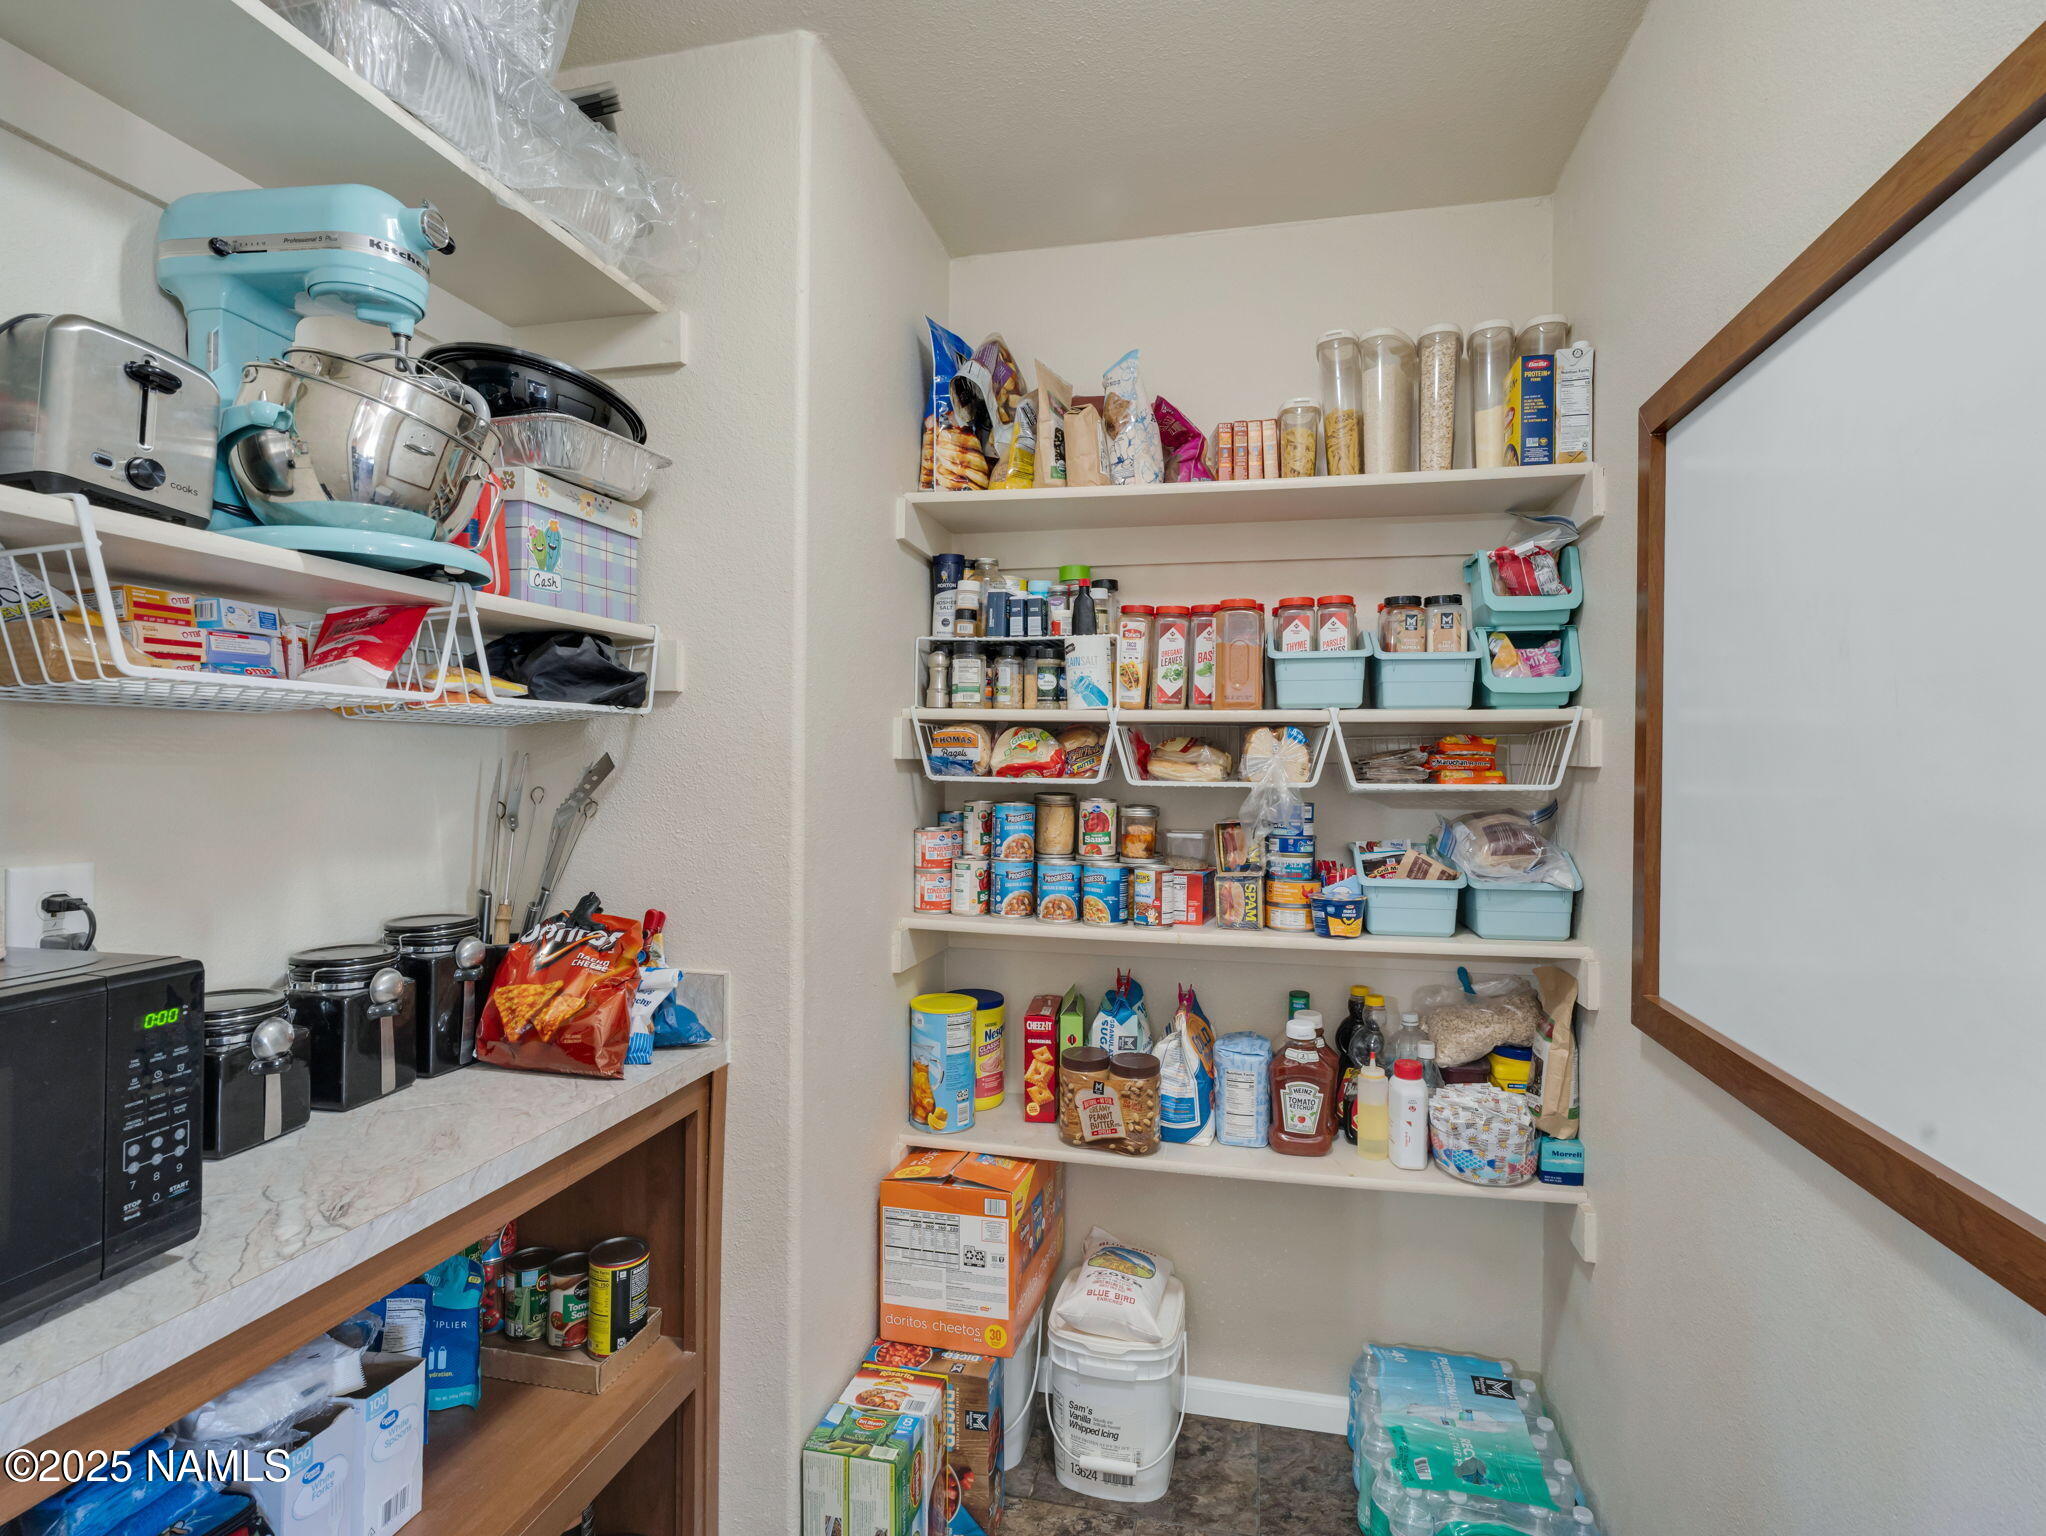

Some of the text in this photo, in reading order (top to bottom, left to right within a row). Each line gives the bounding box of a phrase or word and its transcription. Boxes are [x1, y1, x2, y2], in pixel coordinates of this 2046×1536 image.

[170, 482, 199, 496] cooks
[533, 573, 558, 588] Cash
[1286, 639, 1308, 651] THYME
[1322, 635, 1346, 648] PARSLEY
[1161, 655, 1183, 667] LEAVES
[1197, 650, 1213, 663] BAS
[1076, 758, 1095, 770] BUTTER
[1084, 835, 1110, 843] Sauce
[1044, 873, 1073, 883] PROGRESSO
[1244, 883, 1257, 921] SPAM
[571, 959, 609, 972] CHEESE
[576, 952, 610, 967] NACHO
[144, 1008, 179, 1029] 0:00
[1100, 1020, 1109, 1049] SUG
[1293, 1087, 1313, 1096] HEINZ
[1288, 1097, 1316, 1106] TOMATO
[1289, 1103, 1315, 1111] KETCHUP
[1089, 1104, 1111, 1113] CREAMY
[1089, 1111, 1113, 1122] PEANUT
[1090, 1120, 1115, 1130] BUTTER
[1551, 1150, 1582, 1158] Morrell
[176, 1163, 183, 1172] 9
[153, 1172, 160, 1181] 8
[129, 1181, 136, 1190] 7
[169, 1180, 189, 1193] START
[153, 1192, 160, 1201] 0
[123, 1200, 142, 1211] STOP
[1086, 1289, 1136, 1305] BLUE BIRD
[1096, 1296, 1124, 1306] ENRICHED
[568, 1303, 587, 1312] Tom
[571, 1312, 587, 1320] Sau
[434, 1320, 467, 1329] IPLIER
[885, 1314, 980, 1337] doritos cheetos
[989, 1328, 1001, 1342] 30
[880, 1371, 914, 1380] Rosarita
[369, 1393, 387, 1411] 100
[1069, 1400, 1093, 1415] Sam's
[903, 1417, 914, 1427] 8
[1069, 1410, 1092, 1424] Vanilla
[389, 1418, 410, 1436] White
[1069, 1419, 1119, 1442] Whipped Icing
[384, 1425, 412, 1448] Spoons
[291, 1446, 312, 1467] 100
[312, 1470, 335, 1491] White
[312, 1482, 335, 1501] Forks
